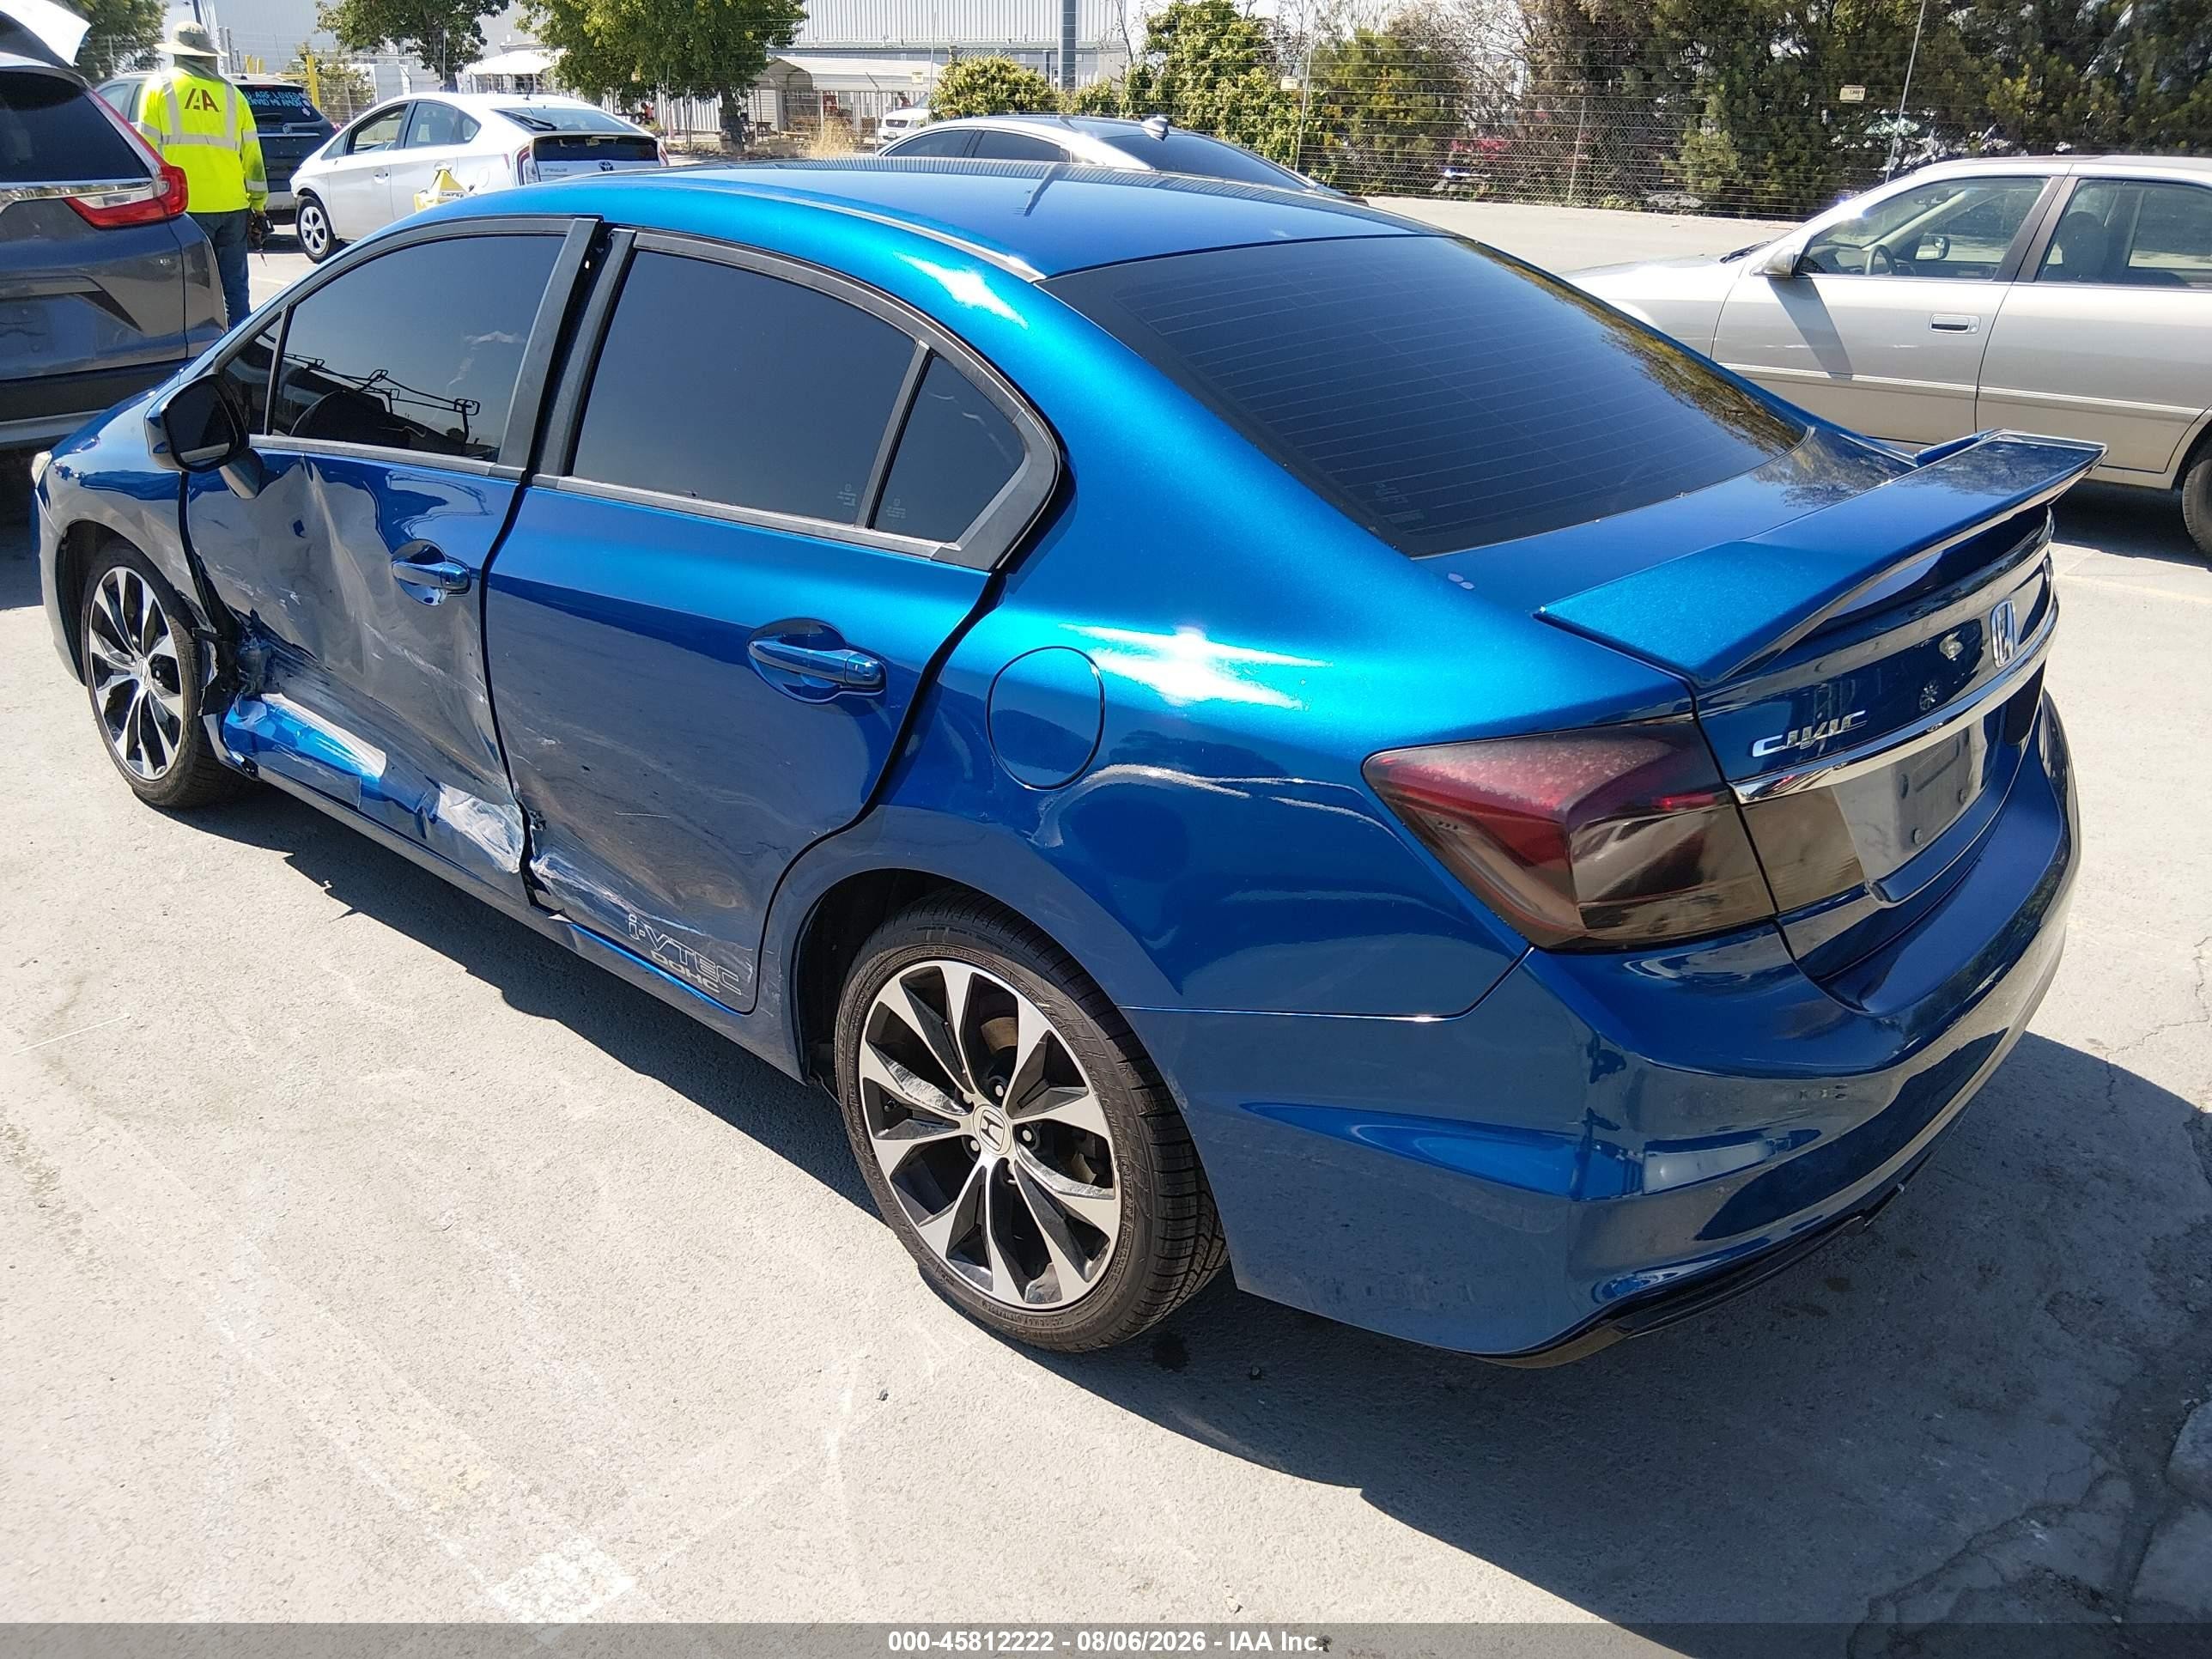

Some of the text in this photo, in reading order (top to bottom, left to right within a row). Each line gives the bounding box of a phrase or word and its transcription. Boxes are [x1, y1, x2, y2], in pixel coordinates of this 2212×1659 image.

[255, 90, 270, 100] ARE
[1752, 709, 1867, 757] CIVIC
[627, 913, 742, 996] i-VTEC
[650, 950, 720, 994] DOHC
